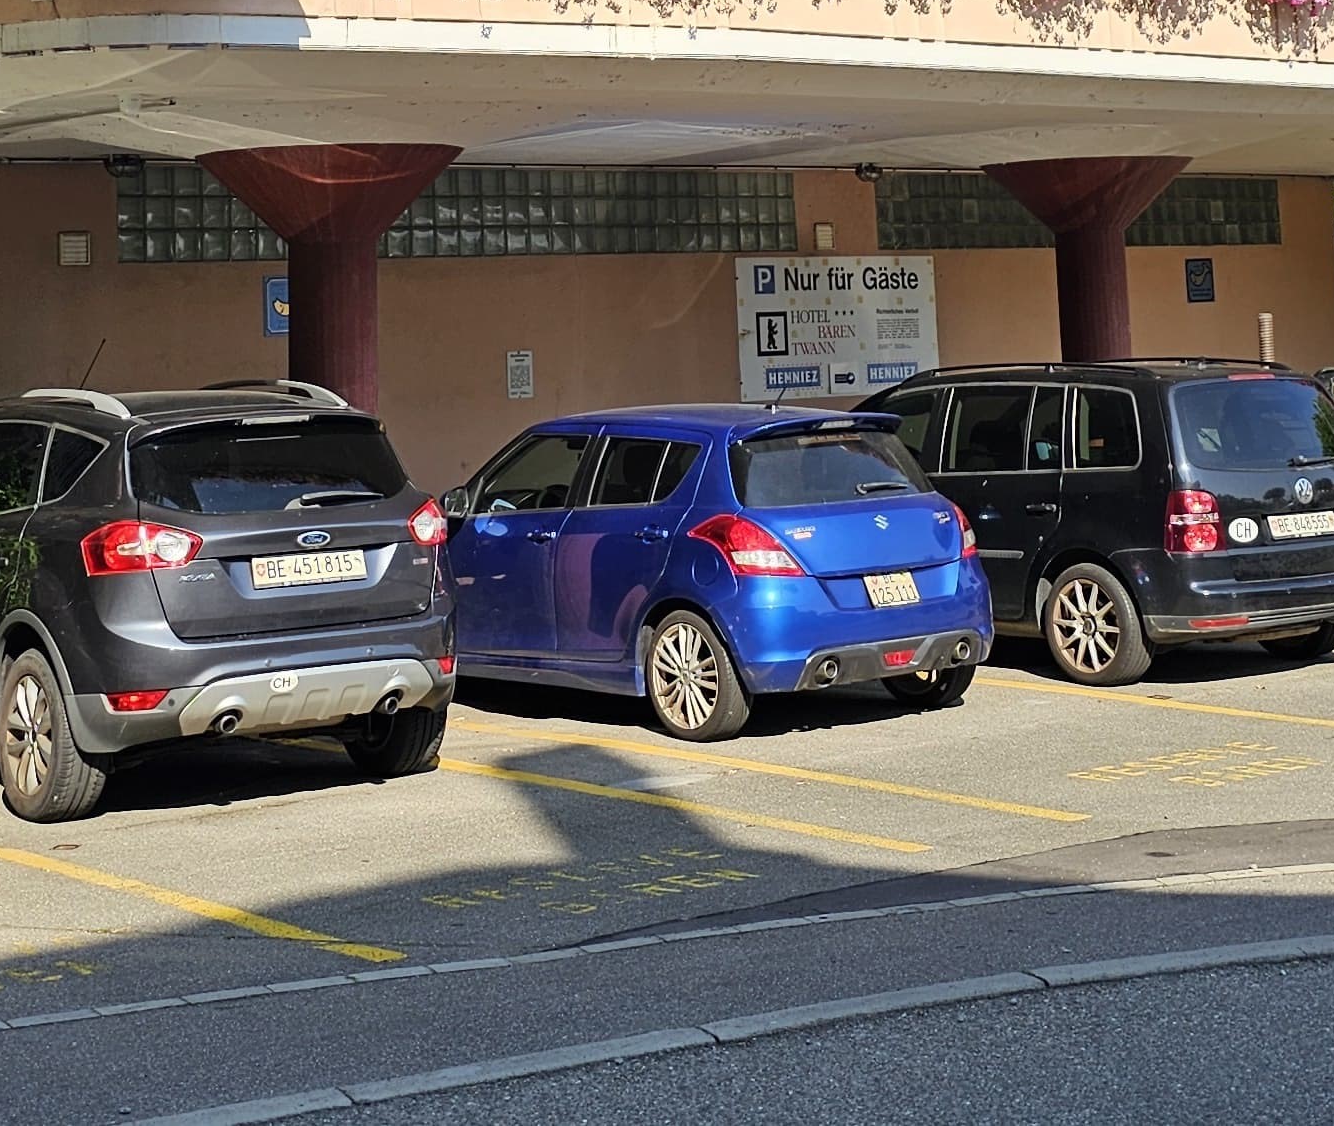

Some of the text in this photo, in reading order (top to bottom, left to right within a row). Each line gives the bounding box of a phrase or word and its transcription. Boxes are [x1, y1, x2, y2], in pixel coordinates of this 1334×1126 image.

[758, 267, 919, 292] P Nur für Gäste
[791, 310, 831, 324] HOTEL
[791, 341, 836, 356] TWANN
[768, 370, 818, 385] HENNIEZ
[1236, 521, 1251, 539] CH
[273, 677, 291, 689] CH
